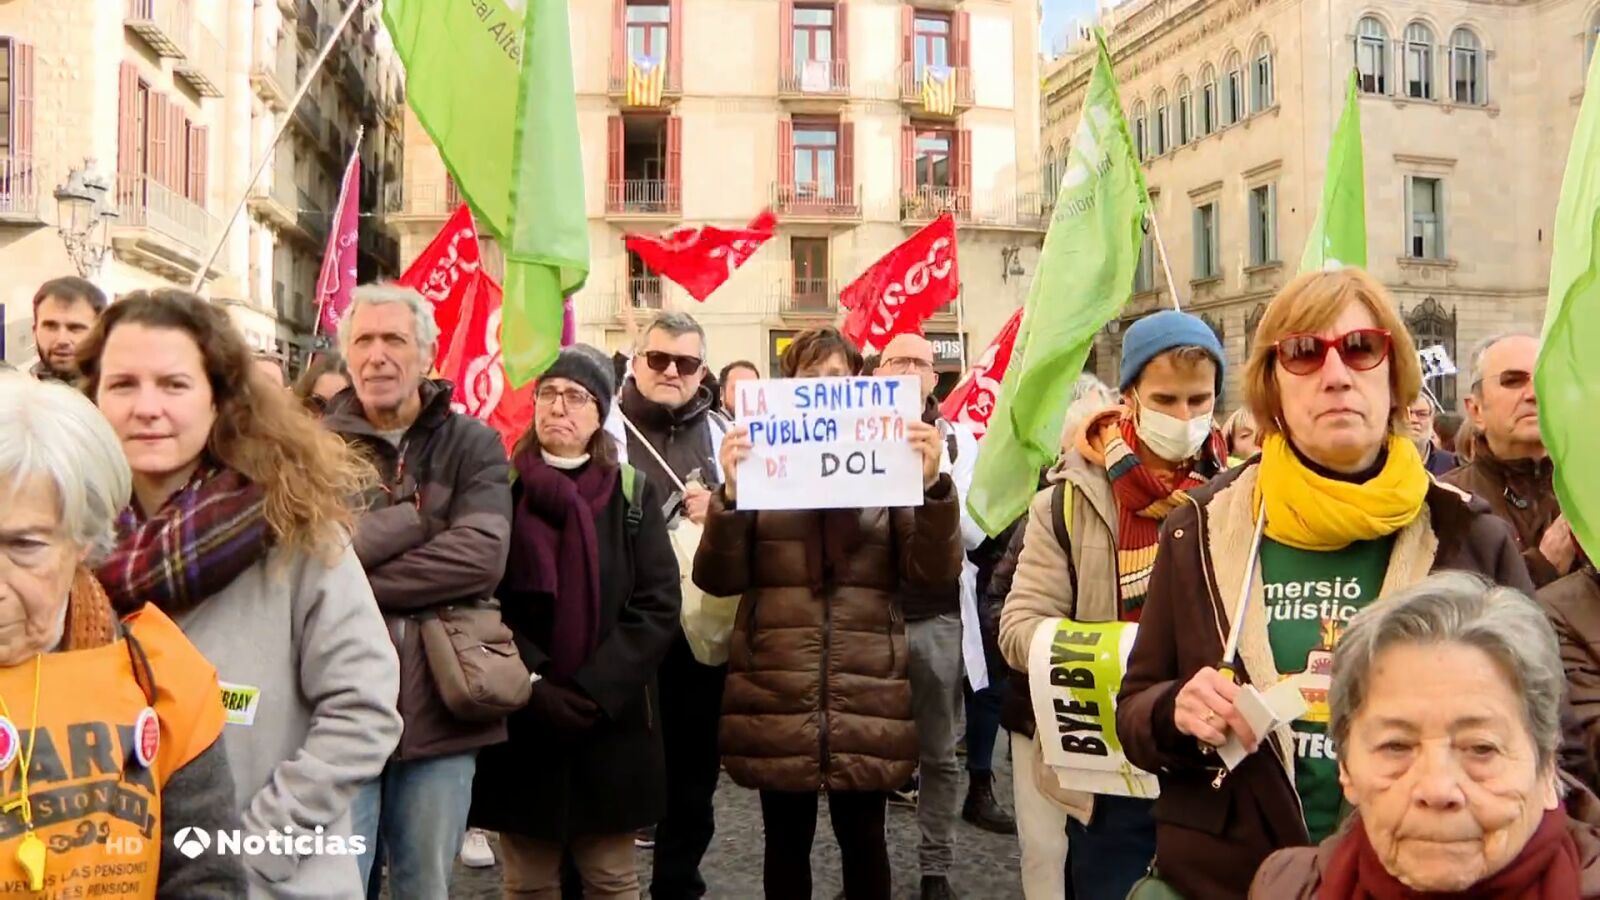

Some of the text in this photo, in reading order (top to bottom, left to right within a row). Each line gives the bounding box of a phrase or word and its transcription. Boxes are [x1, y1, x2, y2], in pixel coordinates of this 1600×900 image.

[487, 22, 522, 65] Alte
[742, 378, 900, 417] LA SANITAT
[749, 412, 838, 446] PÚBLICA
[820, 449, 886, 478] DOL
[220, 689, 254, 712] BRAY
[1049, 629, 1108, 757] BYE BYE
